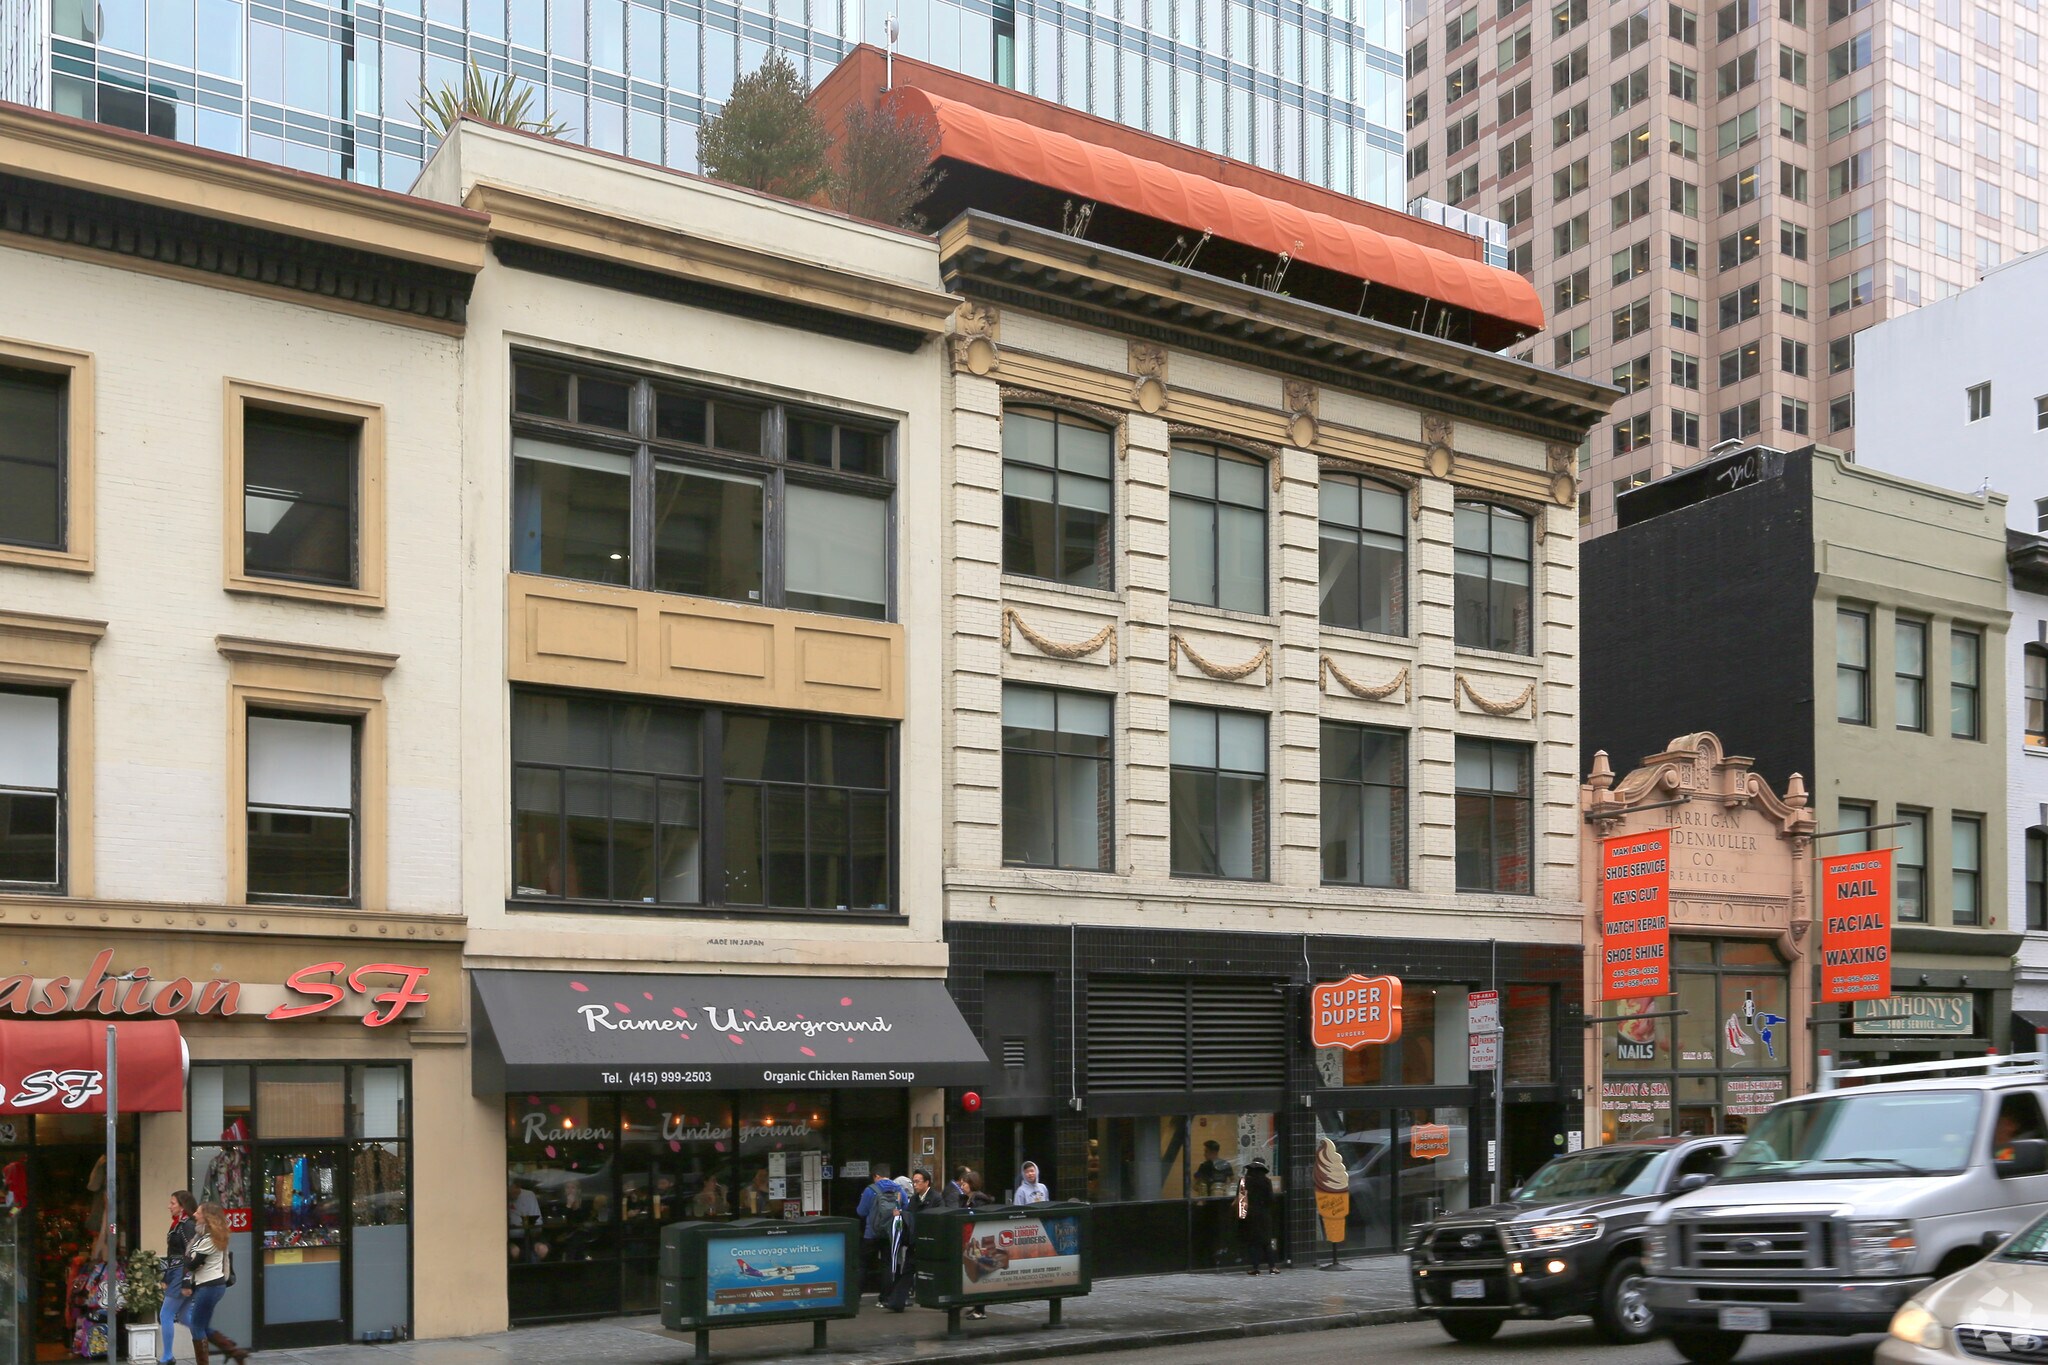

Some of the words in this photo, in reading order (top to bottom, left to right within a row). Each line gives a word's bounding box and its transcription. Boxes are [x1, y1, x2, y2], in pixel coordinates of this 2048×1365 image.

[1665, 809, 1741, 829] HARRIGAN
[1612, 848, 1629, 857] MAK
[1631, 844, 1646, 854] AND
[1648, 842, 1662, 852] CO.
[1669, 829, 1757, 851] IDENMULLER
[1606, 865, 1628, 880] SHOE
[1630, 859, 1666, 877] SERVICE
[1669, 870, 1736, 884] REALTORS
[1830, 865, 1848, 874] MAK
[1850, 862, 1866, 872] AND
[1868, 860, 1882, 870] CO.
[1612, 889, 1637, 906] KEYS
[1638, 887, 1659, 902] CUT
[1837, 879, 1878, 901] NAIL
[1606, 918, 1635, 936] WATCH
[1637, 916, 1667, 932] REPAIR
[1828, 912, 1884, 935] FACIAL
[706, 938, 728, 946] MADE
[1606, 947, 1632, 964] SHOE
[1635, 944, 1664, 960] SHINE
[1826, 944, 1888, 967] WAXING
[265, 961, 430, 1028] SF
[1322, 987, 1381, 1008] SUPER
[1468, 1000, 1478, 1008] NO
[577, 1004, 699, 1033] Ramen
[702, 1006, 893, 1037] Underground
[1321, 1006, 1381, 1027] DUPER
[1866, 997, 1963, 1025] ANTHONY'S
[1336, 1030, 1366, 1038] BURGERS
[1887, 1020, 1905, 1029] SHOE
[1907, 1020, 1935, 1029] SERVICE
[1618, 1044, 1654, 1060] NAILS
[601, 1072, 623, 1084] Tel.
[629, 1071, 658, 1085] (415)
[660, 1071, 712, 1083] 999-2503
[763, 1070, 806, 1084] Organic
[808, 1070, 849, 1082] Chicken
[852, 1070, 888, 1082] Ramen
[888, 1070, 916, 1083] Soup
[11, 1069, 103, 1108] SF
[1602, 1082, 1639, 1097] SALON
[1640, 1082, 1650, 1096] &
[1650, 1082, 1670, 1096] SPA
[521, 1112, 612, 1144] Ramen
[1414, 1142, 1448, 1151] BREAKFAST
[731, 1248, 756, 1257] Come
[758, 1246, 788, 1257] voyage
[790, 1244, 809, 1253] with
